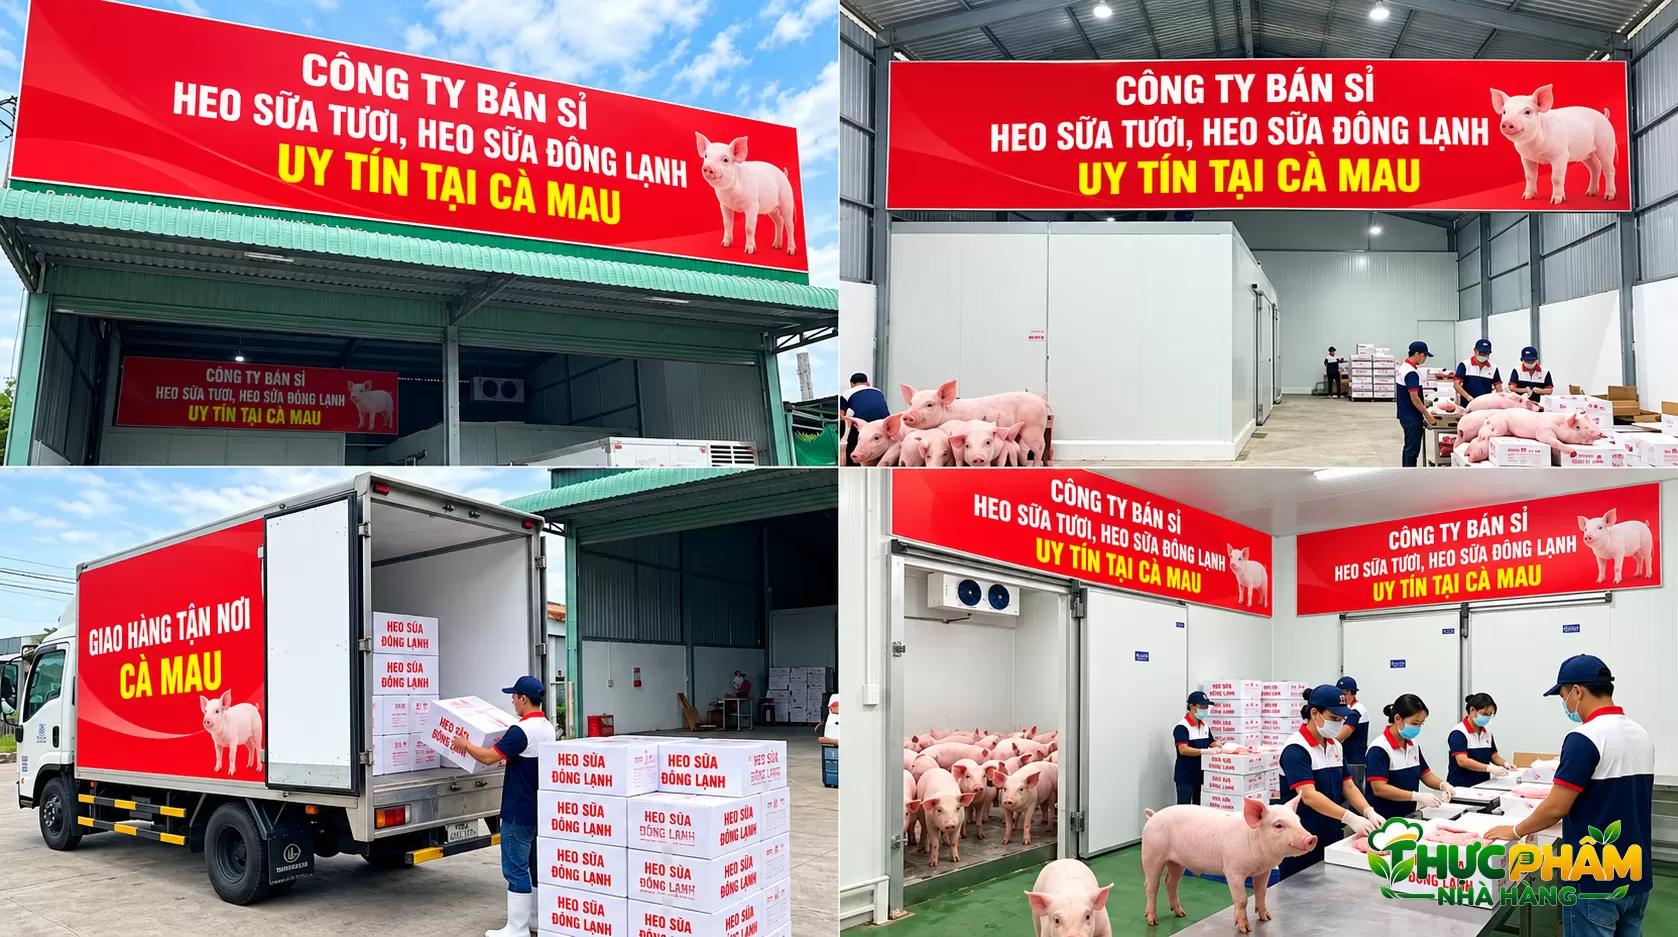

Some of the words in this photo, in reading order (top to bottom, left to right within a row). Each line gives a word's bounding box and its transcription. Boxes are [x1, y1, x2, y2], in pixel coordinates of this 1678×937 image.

[303, 51, 409, 101] CÔNG
[421, 73, 465, 108] TY
[477, 82, 546, 123] BÁN
[557, 91, 587, 130] SỈ
[1116, 69, 1204, 106] CÔNG
[1215, 74, 1256, 103] TY
[1266, 66, 1332, 103] BÁN
[1344, 64, 1374, 103] SỈ
[173, 81, 241, 122] HEO
[253, 90, 318, 133] SỮA
[328, 104, 407, 150] TƯƠI,
[418, 117, 474, 155] HEO
[483, 125, 538, 165] SỮA
[546, 136, 616, 177] ĐÔNG
[625, 151, 688, 188] LẠNH
[991, 122, 1046, 152] HEO
[1057, 116, 1114, 151] SỮA
[1122, 116, 1192, 152] TƯƠI,
[1204, 116, 1258, 146] HEO
[1268, 110, 1324, 146] SỮA
[1332, 110, 1409, 146] ĐÔNG
[1420, 116, 1489, 152] LẠNH
[278, 143, 334, 186] UY
[345, 147, 408, 197] TÍN
[420, 162, 476, 212] TẠI
[490, 169, 536, 214] CÀ
[548, 180, 620, 226] MAU
[1079, 162, 1127, 196] UY
[1138, 153, 1196, 194] TÍN
[1209, 158, 1264, 200] TẠI
[1278, 150, 1327, 192] CÀ
[1339, 158, 1420, 192] MAU
[206, 366, 242, 384] CÔNG
[246, 370, 261, 384] TY
[265, 368, 290, 386] BÁN
[156, 386, 178, 400] HEO
[240, 390, 260, 402] HEO
[320, 394, 345, 408] LẠNH
[188, 405, 209, 422] UY
[212, 403, 236, 422] TÍN
[240, 407, 262, 426] TẠI
[290, 409, 321, 426] MAU
[1051, 478, 1102, 513] CÔNG
[1106, 494, 1132, 520] TY
[1132, 502, 1163, 530] BÁN
[1167, 508, 1180, 534] SỈ
[974, 494, 1012, 522] HEO
[1017, 503, 1052, 532] SỮA
[1056, 512, 1096, 544] TƯƠI,
[1101, 523, 1128, 548] HEO
[1134, 530, 1159, 556] SỮA
[1162, 538, 1194, 564] ĐÔNG
[1198, 549, 1226, 573] LẠNH
[1389, 525, 1434, 550] CÔNG
[1440, 522, 1461, 542] TY
[1467, 512, 1504, 540] BÁN
[1510, 506, 1528, 534] SỈ
[1036, 537, 1064, 566] UY
[1069, 542, 1100, 574] TÍN
[1106, 552, 1133, 584] TẠI
[1138, 558, 1162, 586] CÀ
[1166, 567, 1202, 594] MAU
[1334, 562, 1359, 582] HEO
[1362, 557, 1388, 578] SỮA
[1392, 552, 1424, 574] TƯƠI,
[1429, 550, 1456, 570] HEO
[1460, 544, 1488, 566] SỮA
[1492, 539, 1532, 562] ĐÔNG
[1537, 534, 1576, 560] LẠNH
[1373, 580, 1396, 602] UY
[1400, 569, 1428, 599] TÍN
[1432, 573, 1460, 600] TẠI
[1466, 566, 1491, 592] CÀ
[1497, 564, 1542, 589] MAU
[89, 624, 122, 656] GIAO
[128, 614, 172, 649] HÀNG
[176, 603, 210, 646] TẬN
[218, 596, 250, 634] NƠI
[387, 621, 404, 632] HEO
[120, 654, 152, 700] CÀ
[161, 650, 222, 696] MAU
[387, 662, 404, 672] HEO
[558, 752, 579, 766] HEO
[668, 754, 690, 768] HEO
[584, 772, 613, 788] LẠNH
[696, 774, 726, 790] LẠNH
[558, 801, 578, 816] HEO
[644, 810, 666, 824] HEO
[724, 810, 738, 826] HEO
[584, 822, 612, 838] LẠNH
[557, 848, 578, 864] HEO
[584, 870, 612, 887] LẠNH
[644, 862, 666, 876] HEO
[724, 861, 738, 879] HEO
[558, 896, 578, 912] HEO
[584, 919, 612, 936] LẠNH
[644, 913, 666, 928] HEO
[726, 912, 740, 932] HEO
